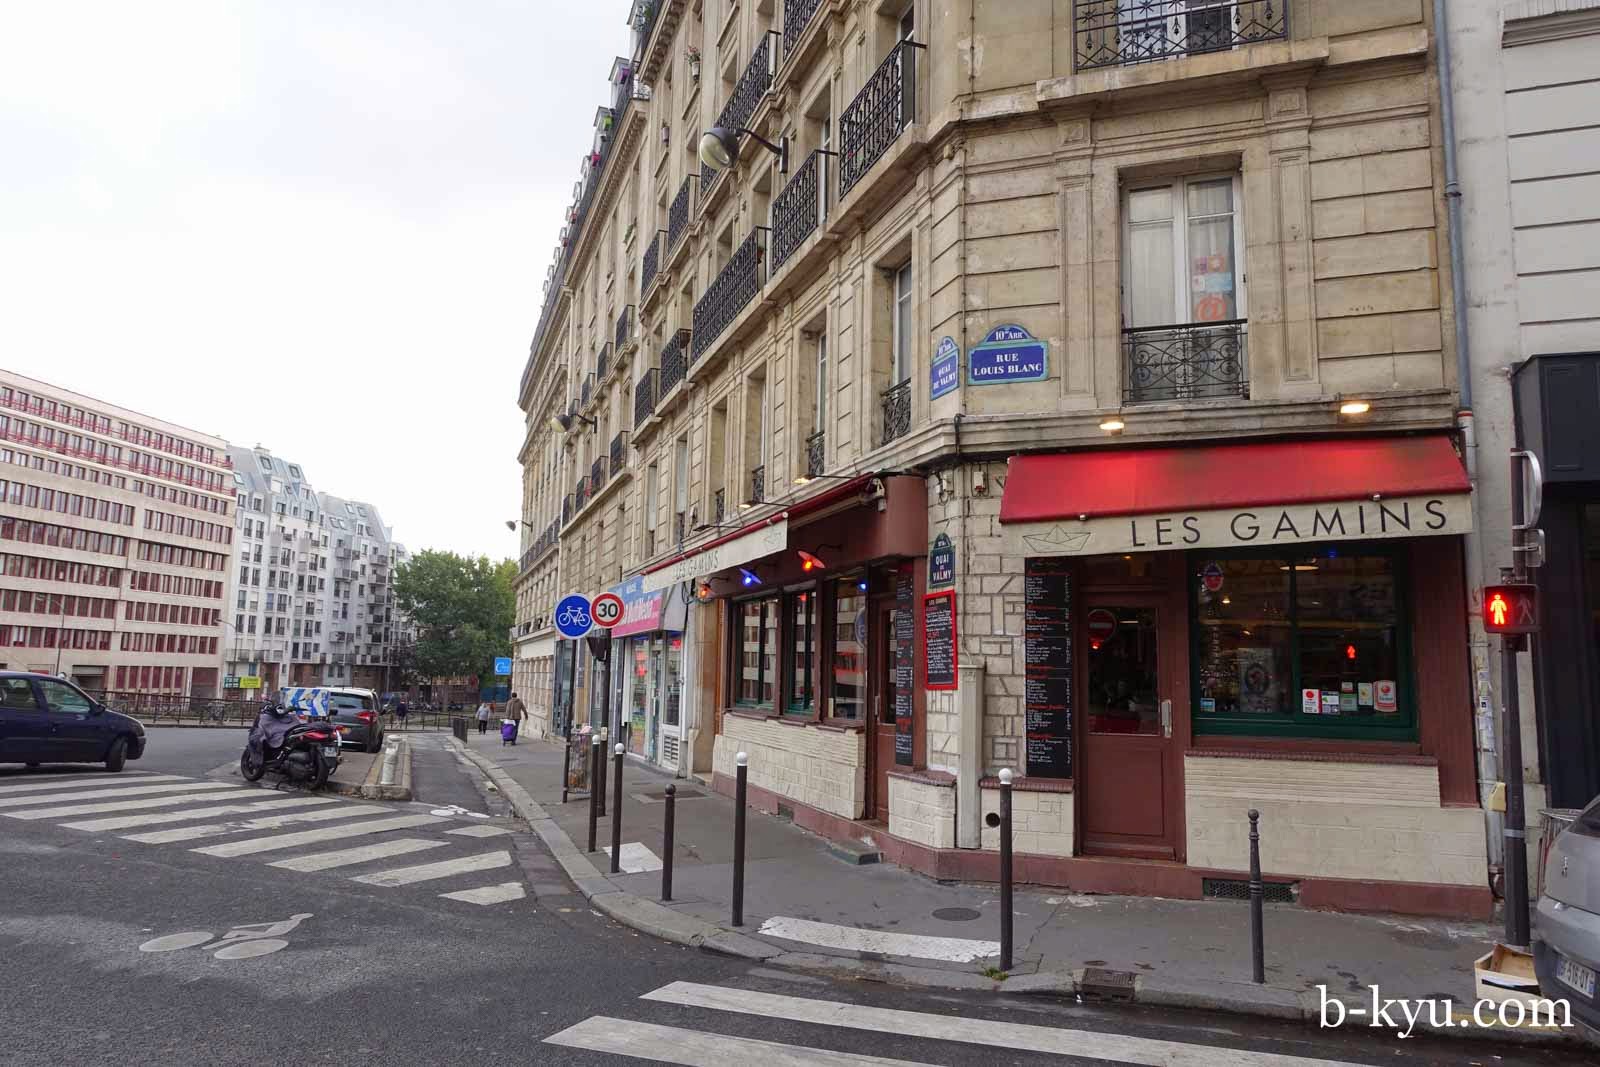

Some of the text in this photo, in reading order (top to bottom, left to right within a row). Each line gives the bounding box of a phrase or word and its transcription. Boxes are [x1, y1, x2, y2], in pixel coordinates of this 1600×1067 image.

[996, 353, 1019, 363] RUE
[974, 362, 1043, 376] LOUIS BLANC
[1131, 499, 1447, 547] LES GAMINS
[936, 554, 949, 565] QUAI
[933, 570, 951, 581] VALMY
[597, 602, 619, 618] 30
